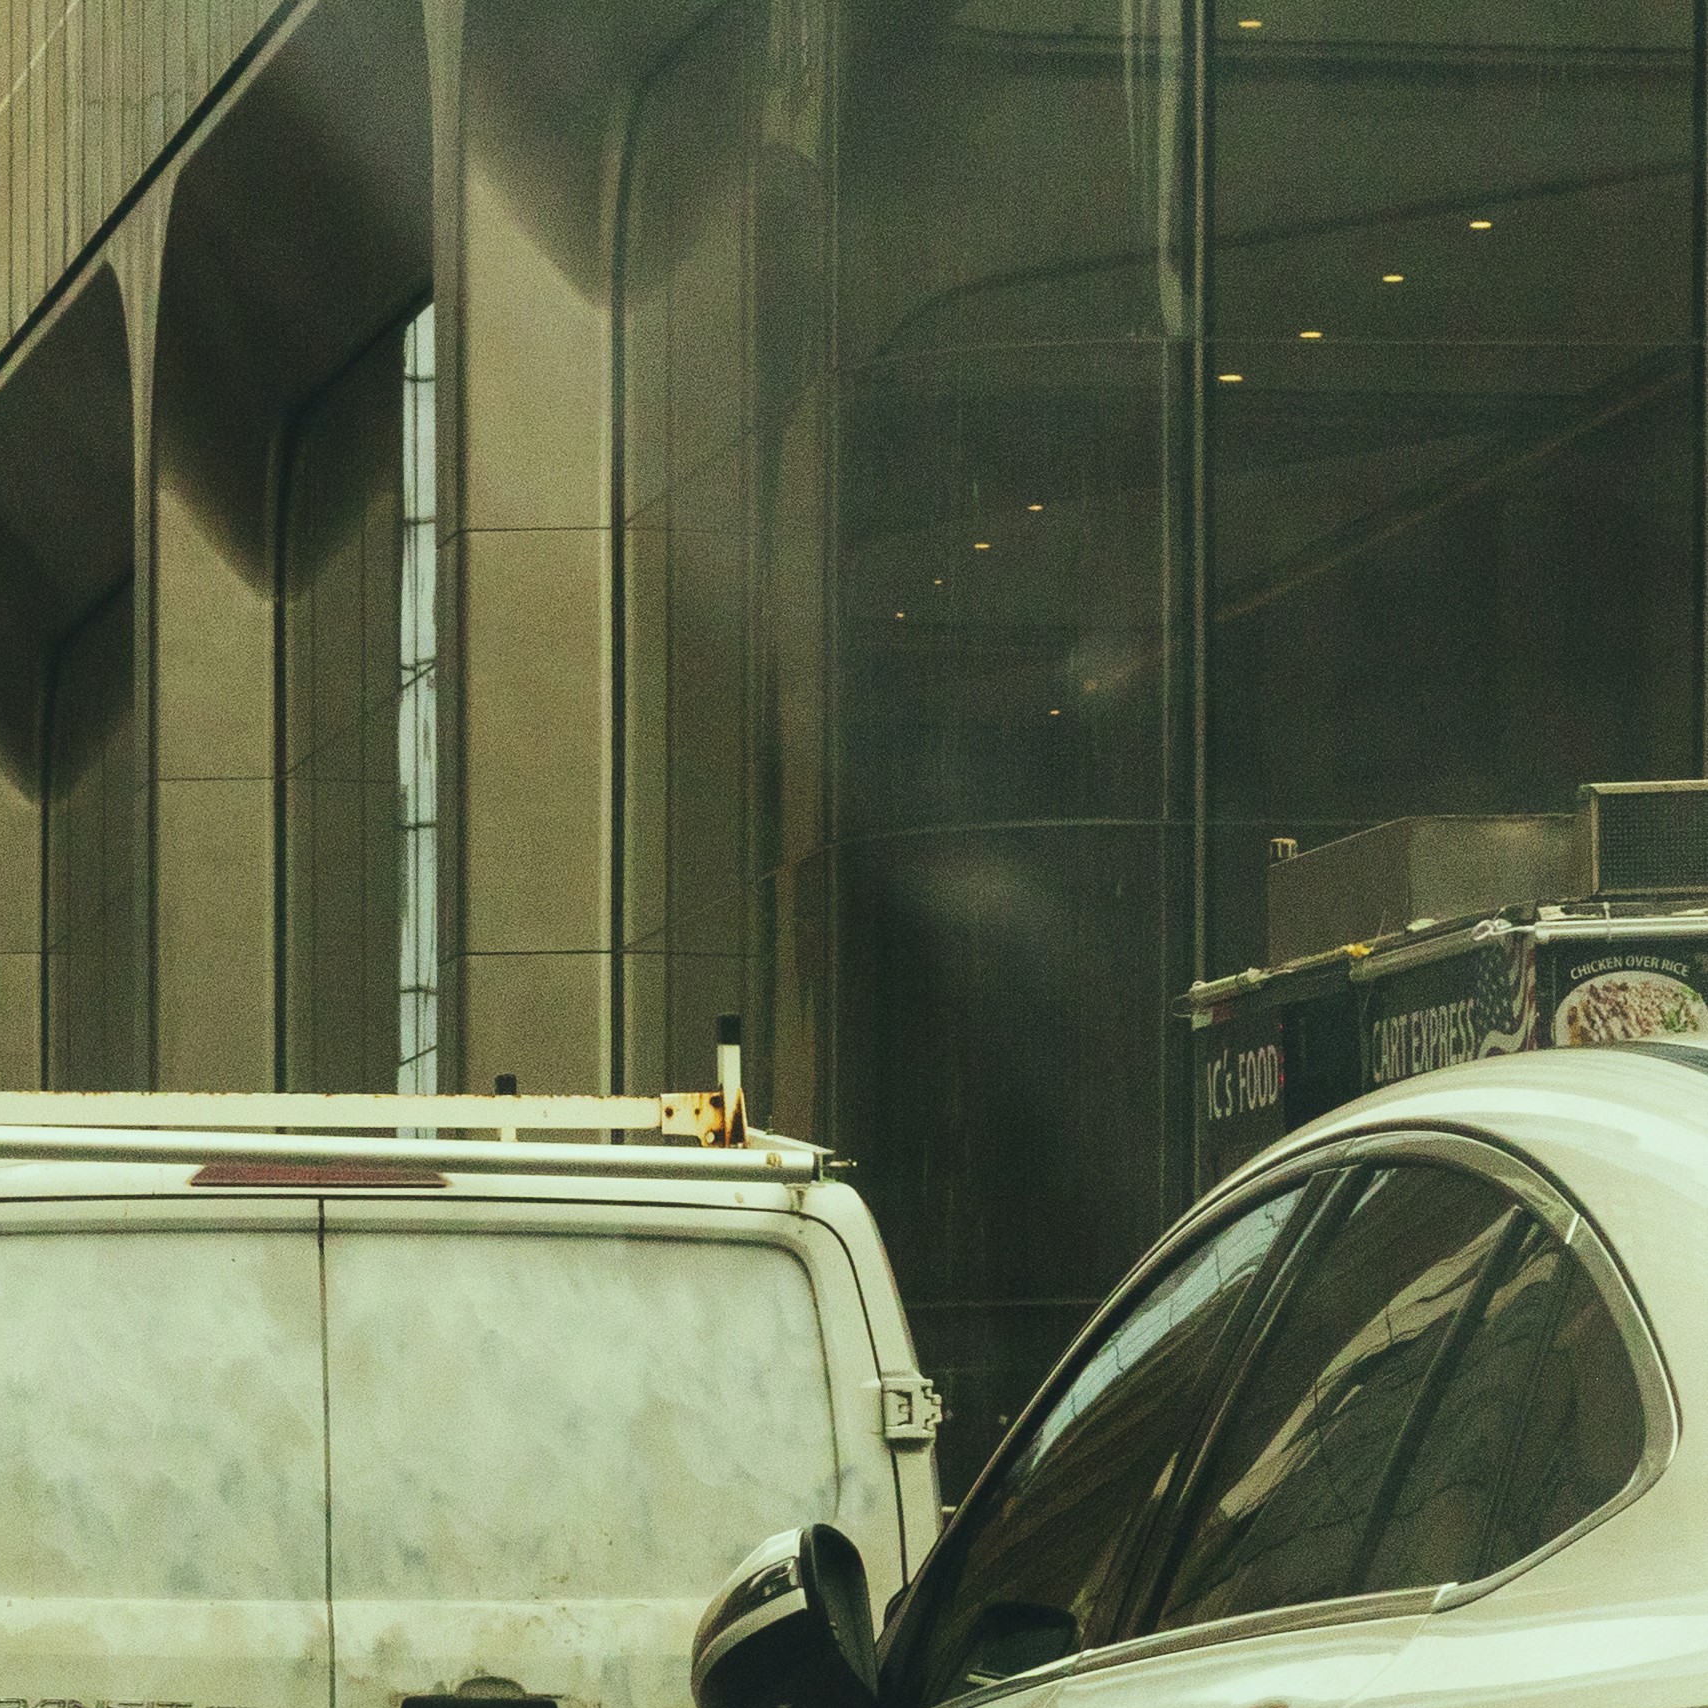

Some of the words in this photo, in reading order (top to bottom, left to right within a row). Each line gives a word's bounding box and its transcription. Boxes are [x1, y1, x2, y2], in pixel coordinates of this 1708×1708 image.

[1570, 956, 1623, 980] CHICKEN
[1625, 955, 1658, 970] OVER
[1661, 959, 1690, 978] RICE
[1373, 1013, 1407, 1083] CART
[1411, 997, 1476, 1075] EXPRESS
[1238, 1044, 1279, 1113] FOOD
